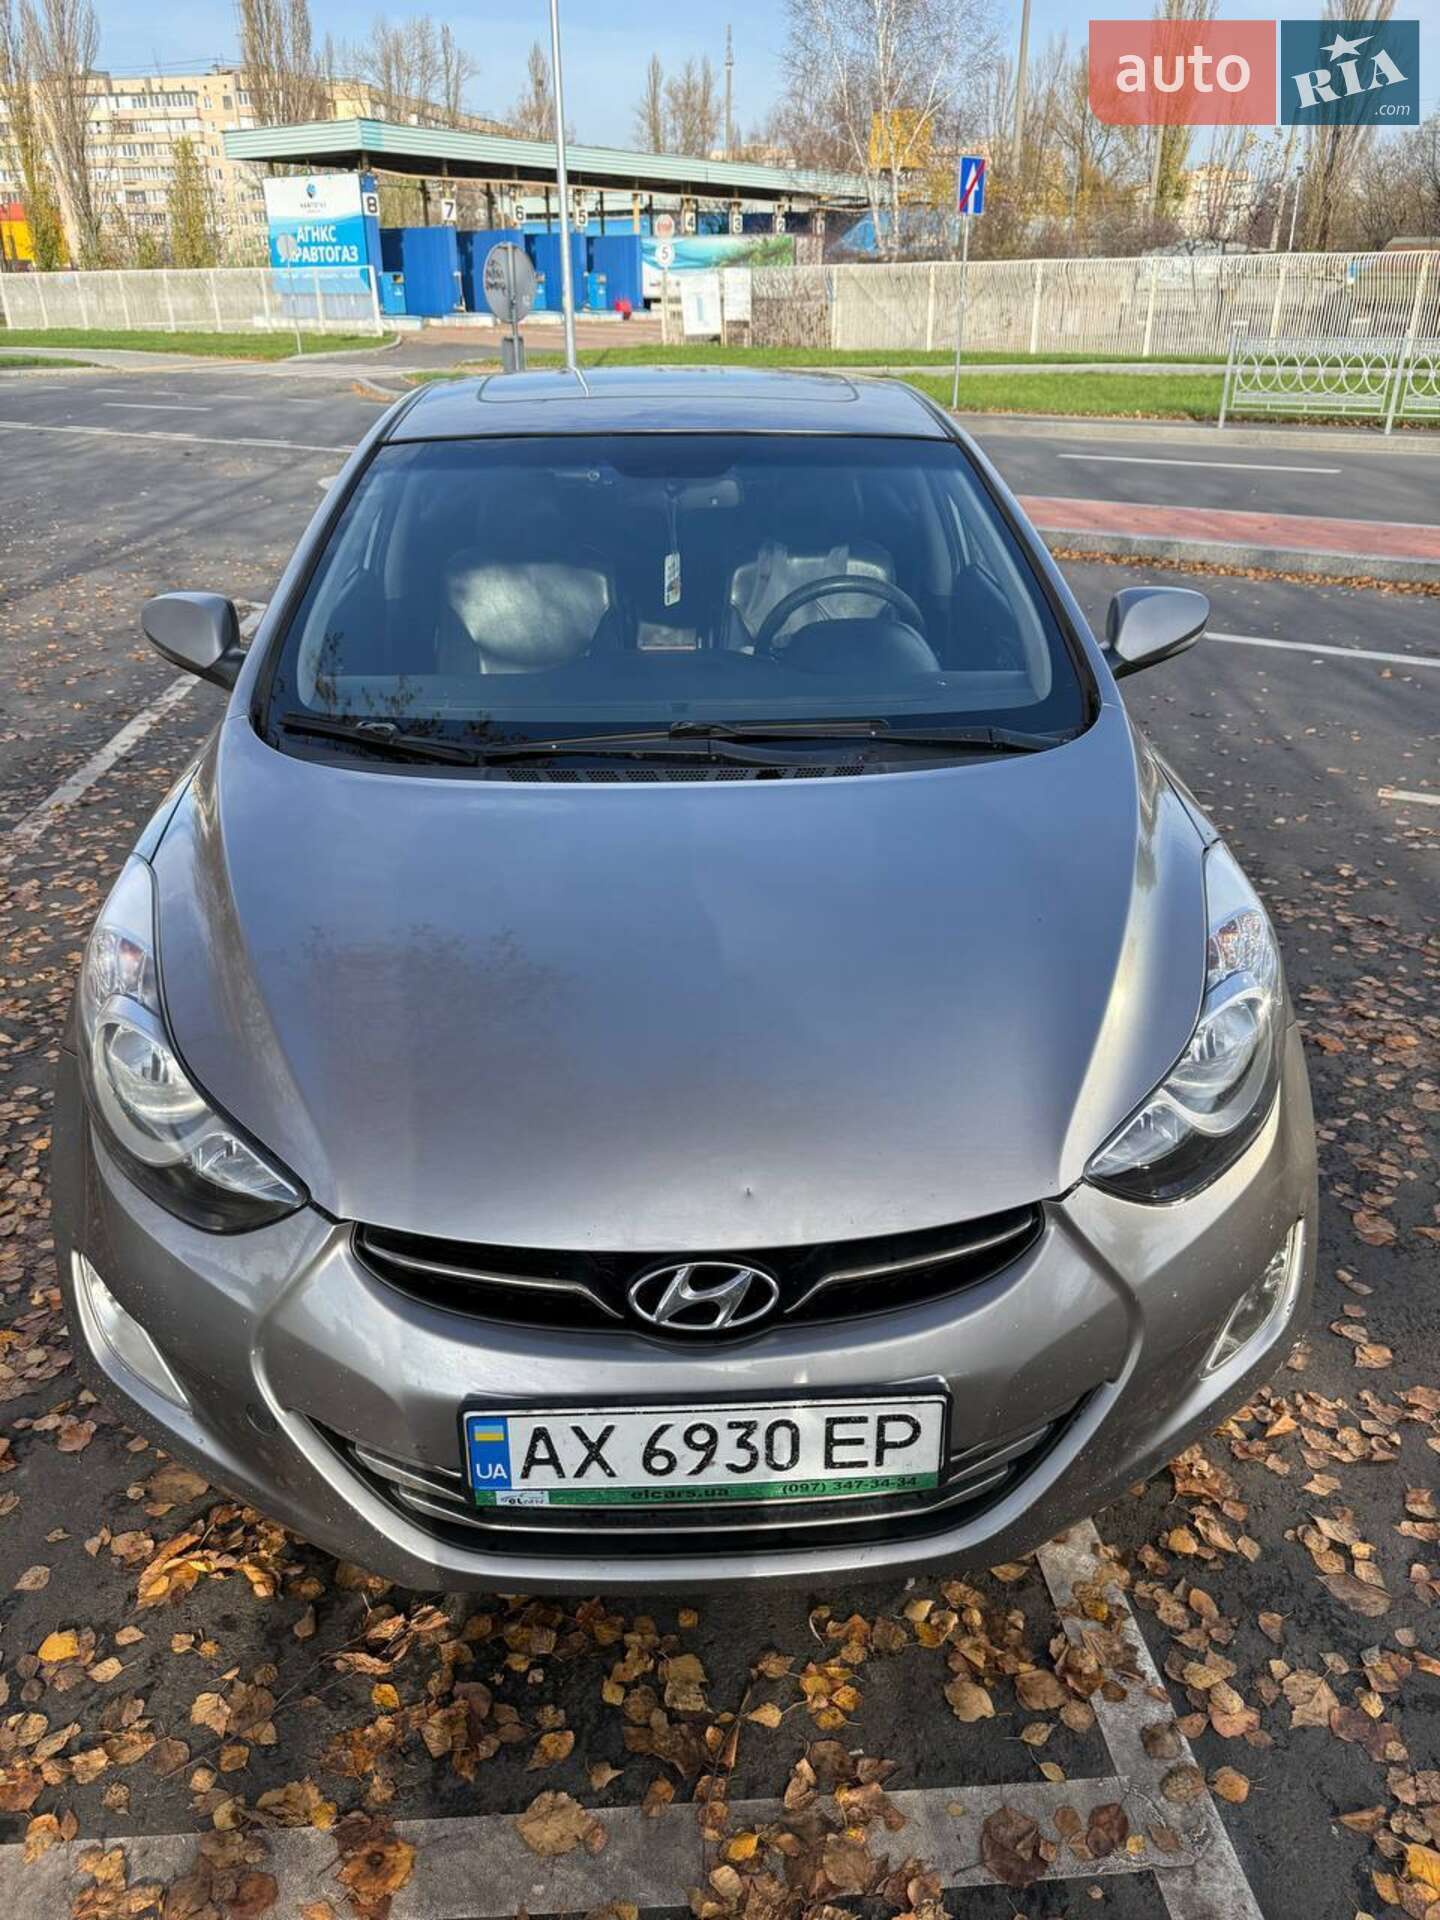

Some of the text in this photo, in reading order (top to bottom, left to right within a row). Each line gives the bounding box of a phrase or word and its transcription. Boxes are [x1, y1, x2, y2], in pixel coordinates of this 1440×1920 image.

[366, 196, 378, 214] 8
[444, 202, 455, 220] 7
[515, 204, 525, 221] 6
[578, 210, 587, 226] 5
[687, 215, 695, 228] 4
[734, 216, 742, 230] 3
[297, 225, 337, 243] АГНКС
[280, 245, 359, 263] РАВТОГАЗ
[660, 245, 670, 261] 5
[520, 1414, 922, 1480] AX 6930 EP
[476, 1463, 507, 1480] UA
[782, 1482, 826, 1494] (097)
